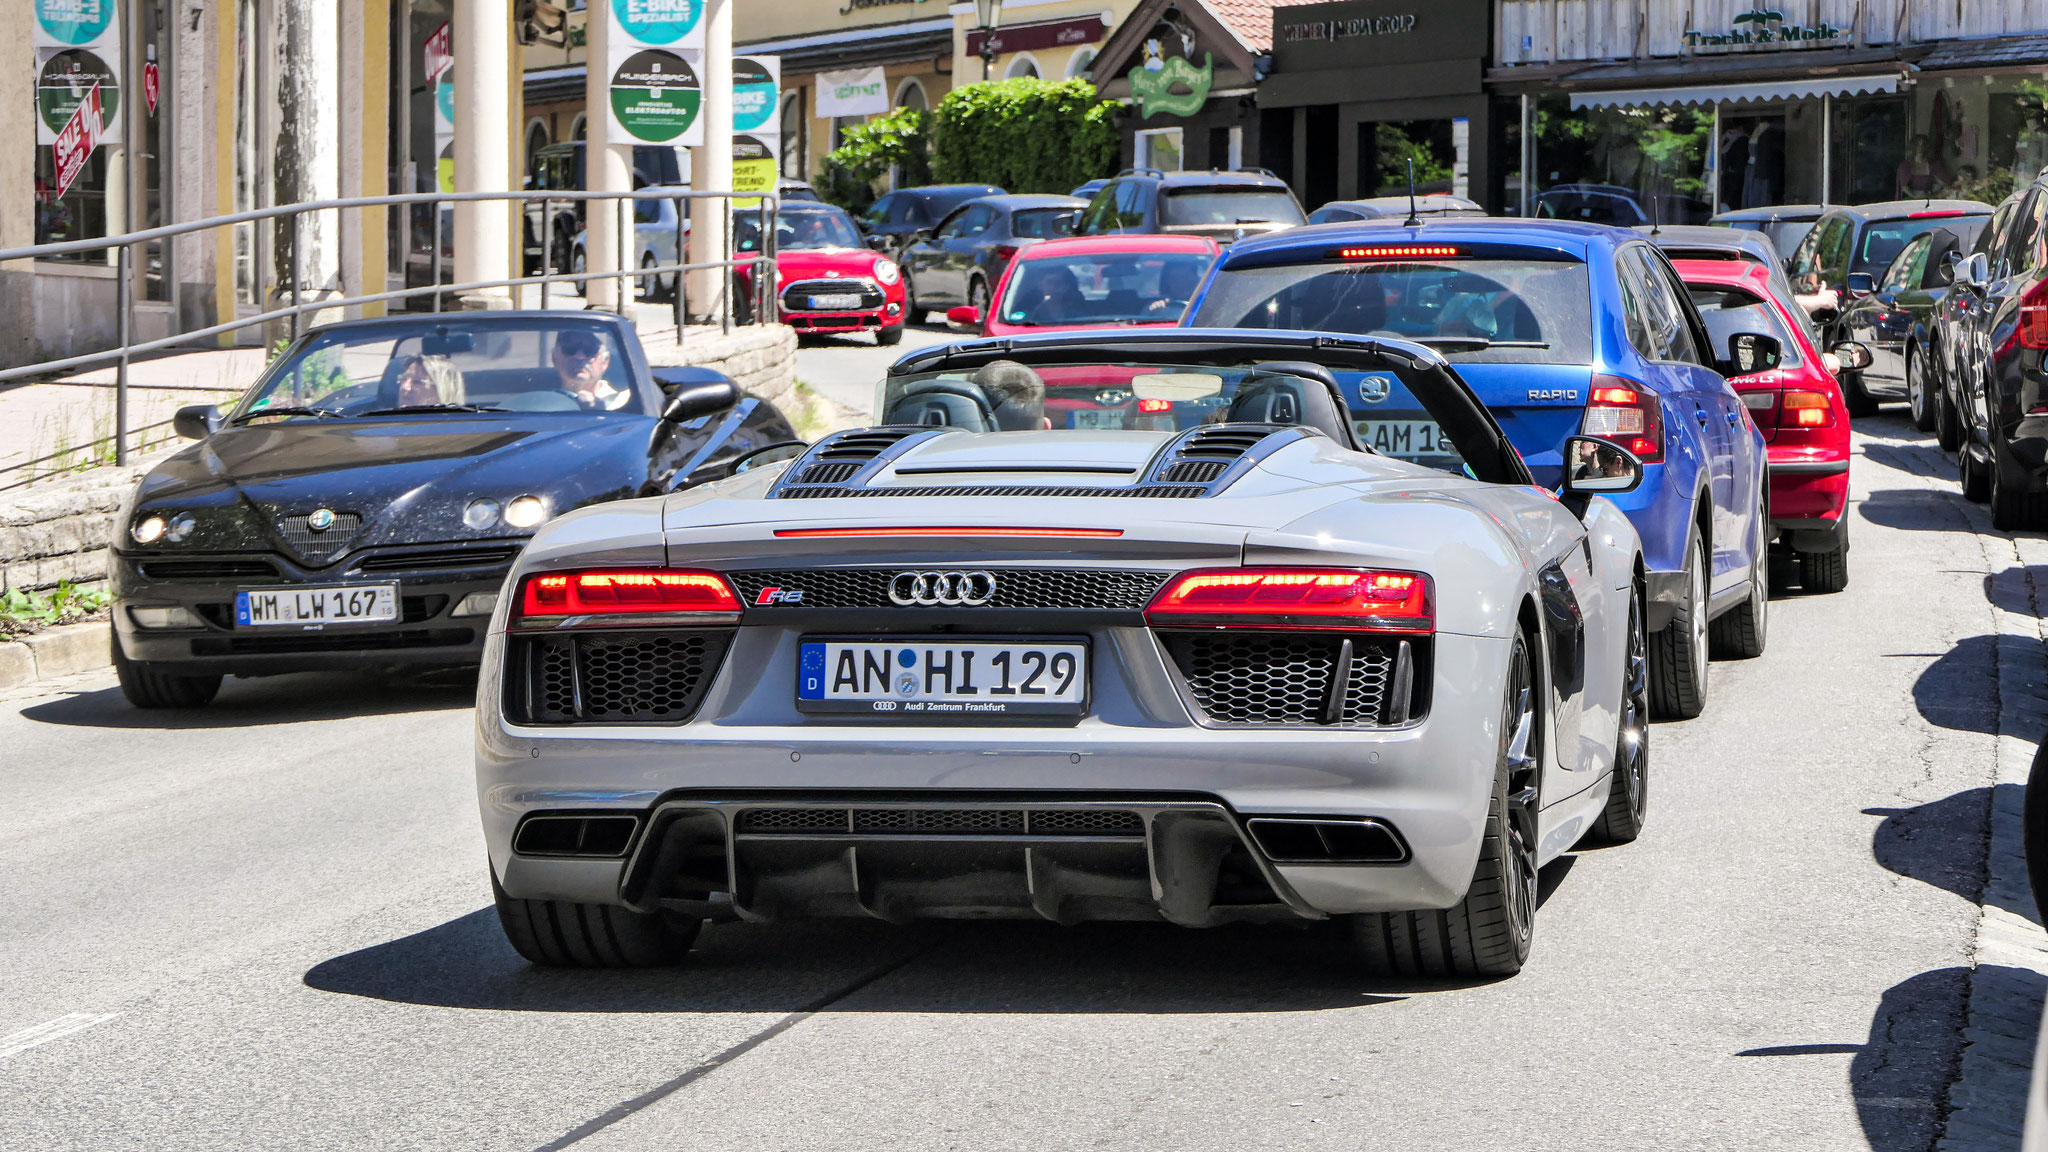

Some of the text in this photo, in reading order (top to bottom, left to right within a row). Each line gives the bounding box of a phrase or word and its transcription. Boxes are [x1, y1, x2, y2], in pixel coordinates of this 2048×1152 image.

[190, 9, 203, 32] 7
[627, 12, 691, 23] SPEZIALIST
[1338, 18, 1372, 38] MEDIA
[1376, 14, 1416, 35] GROUP
[1686, 23, 1840, 46] Tracht & Mode
[733, 91, 766, 105] BIKE
[57, 121, 81, 167] SALE
[1759, 376, 1775, 384] LS
[1527, 388, 1578, 401] RAPID
[1374, 424, 1412, 453] AM
[766, 590, 803, 602] R8
[250, 590, 377, 620] WM LW 167
[240, 612, 248, 620] D
[832, 649, 1078, 697] AN HI 129
[807, 677, 818, 691] D
[904, 702, 1006, 712] Audi Zentrum Frankfurt
